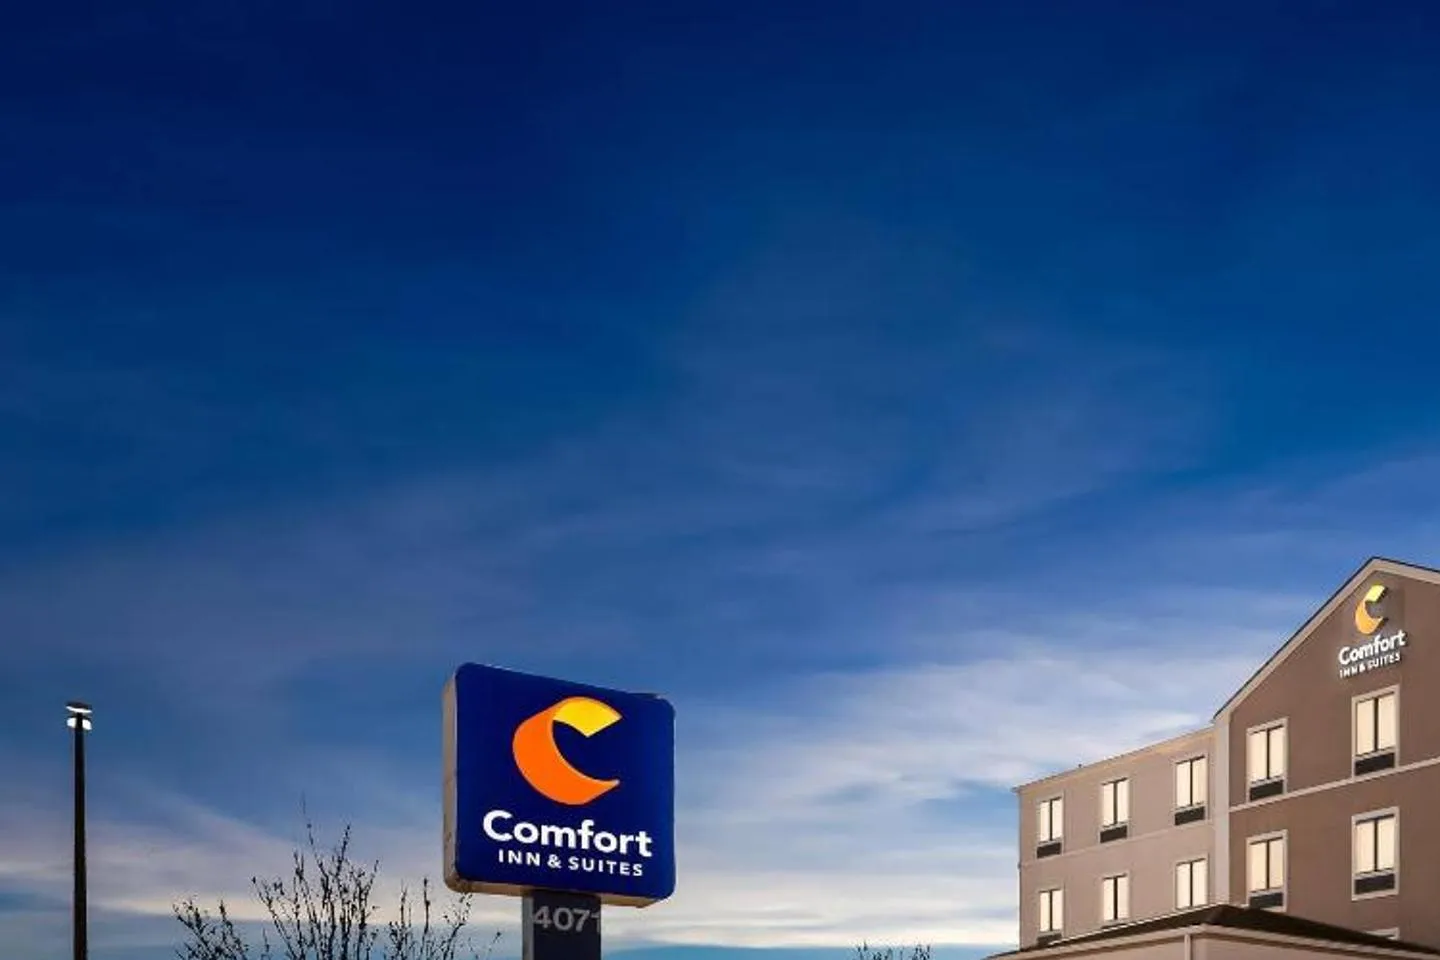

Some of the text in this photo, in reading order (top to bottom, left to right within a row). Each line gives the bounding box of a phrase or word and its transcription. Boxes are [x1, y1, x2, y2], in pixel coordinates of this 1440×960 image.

[1339, 629, 1406, 666] Comfort
[1368, 652, 1401, 671] SUITES
[482, 809, 653, 857] Comfort
[498, 849, 643, 877] INN & SUITES
